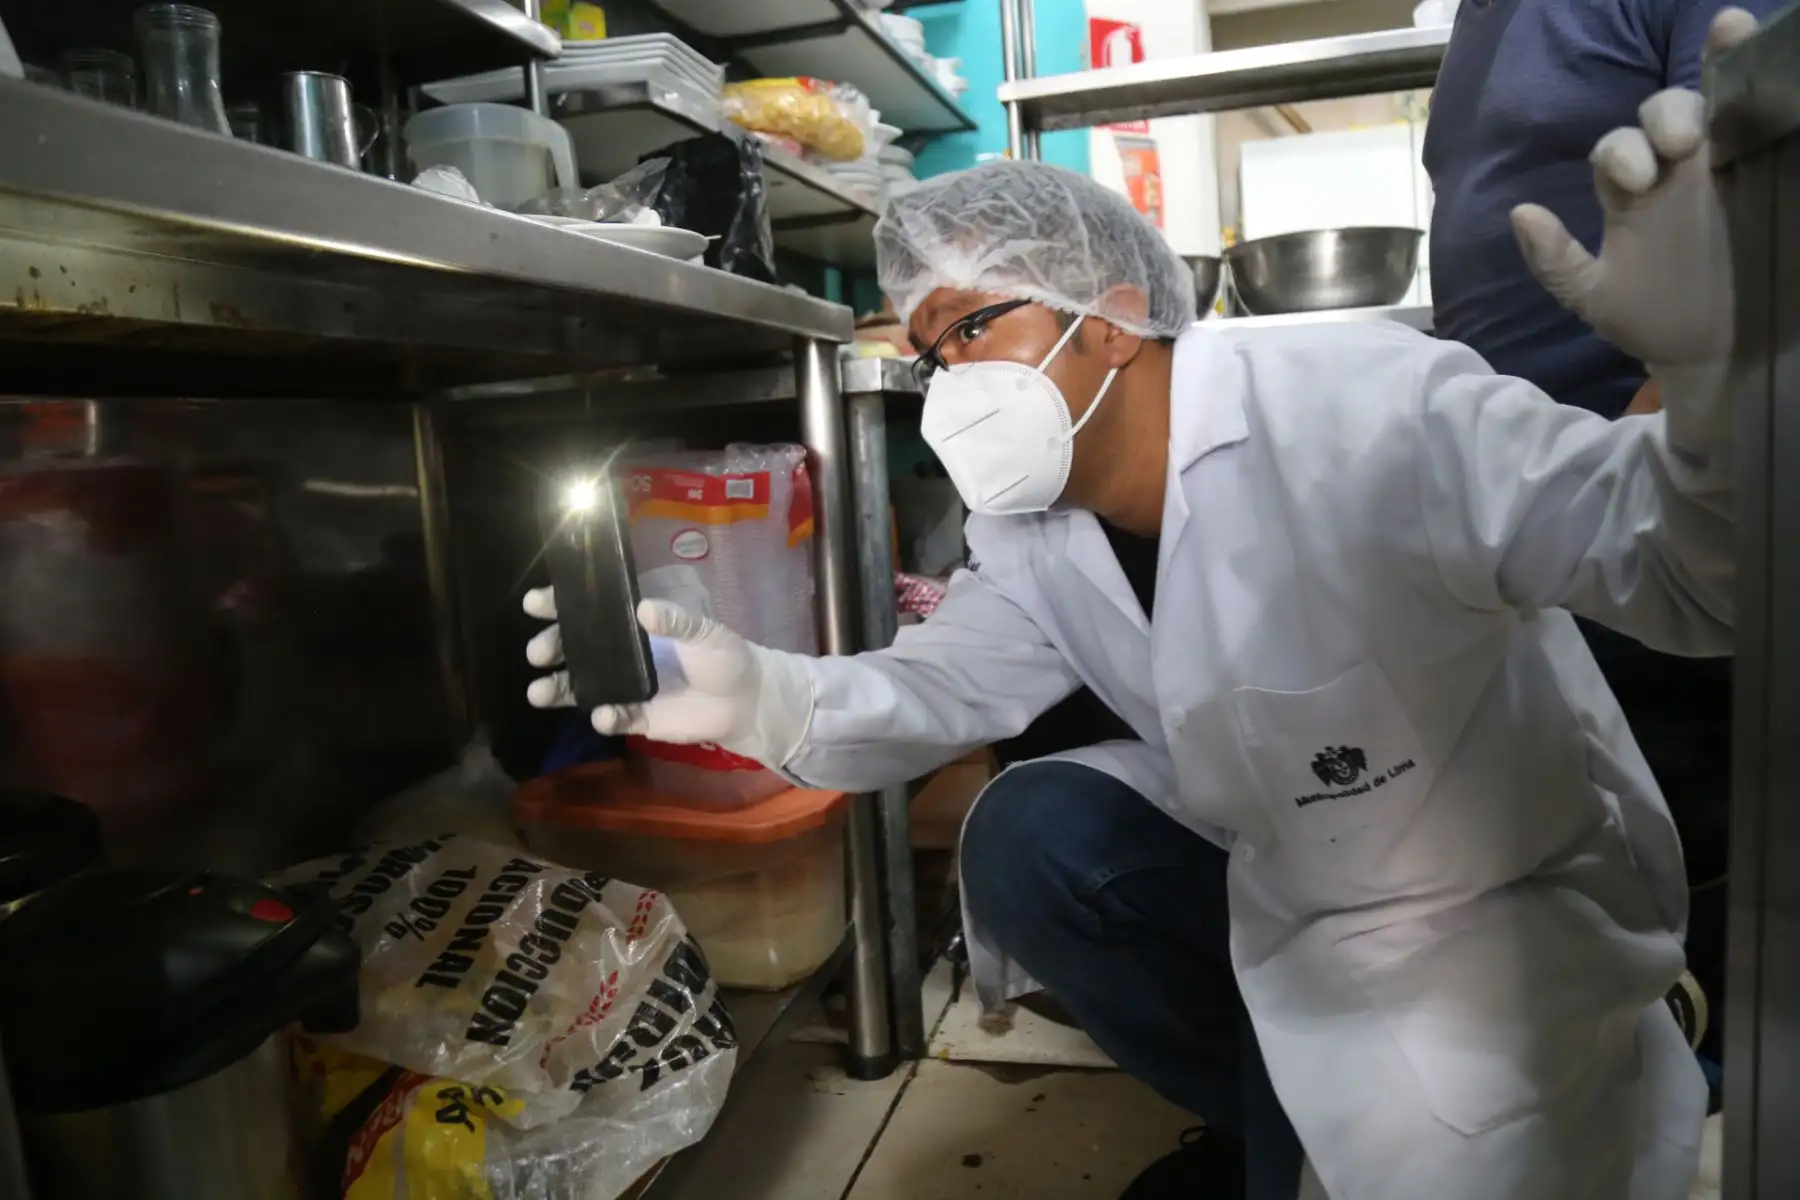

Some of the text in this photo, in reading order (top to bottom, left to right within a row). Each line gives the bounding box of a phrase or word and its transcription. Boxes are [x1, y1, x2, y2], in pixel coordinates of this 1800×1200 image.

[1373, 774, 1387, 787] de
[1387, 758, 1416, 779] Lima
[385, 864, 476, 941] 100%
[415, 857, 549, 989] ACIONAL
